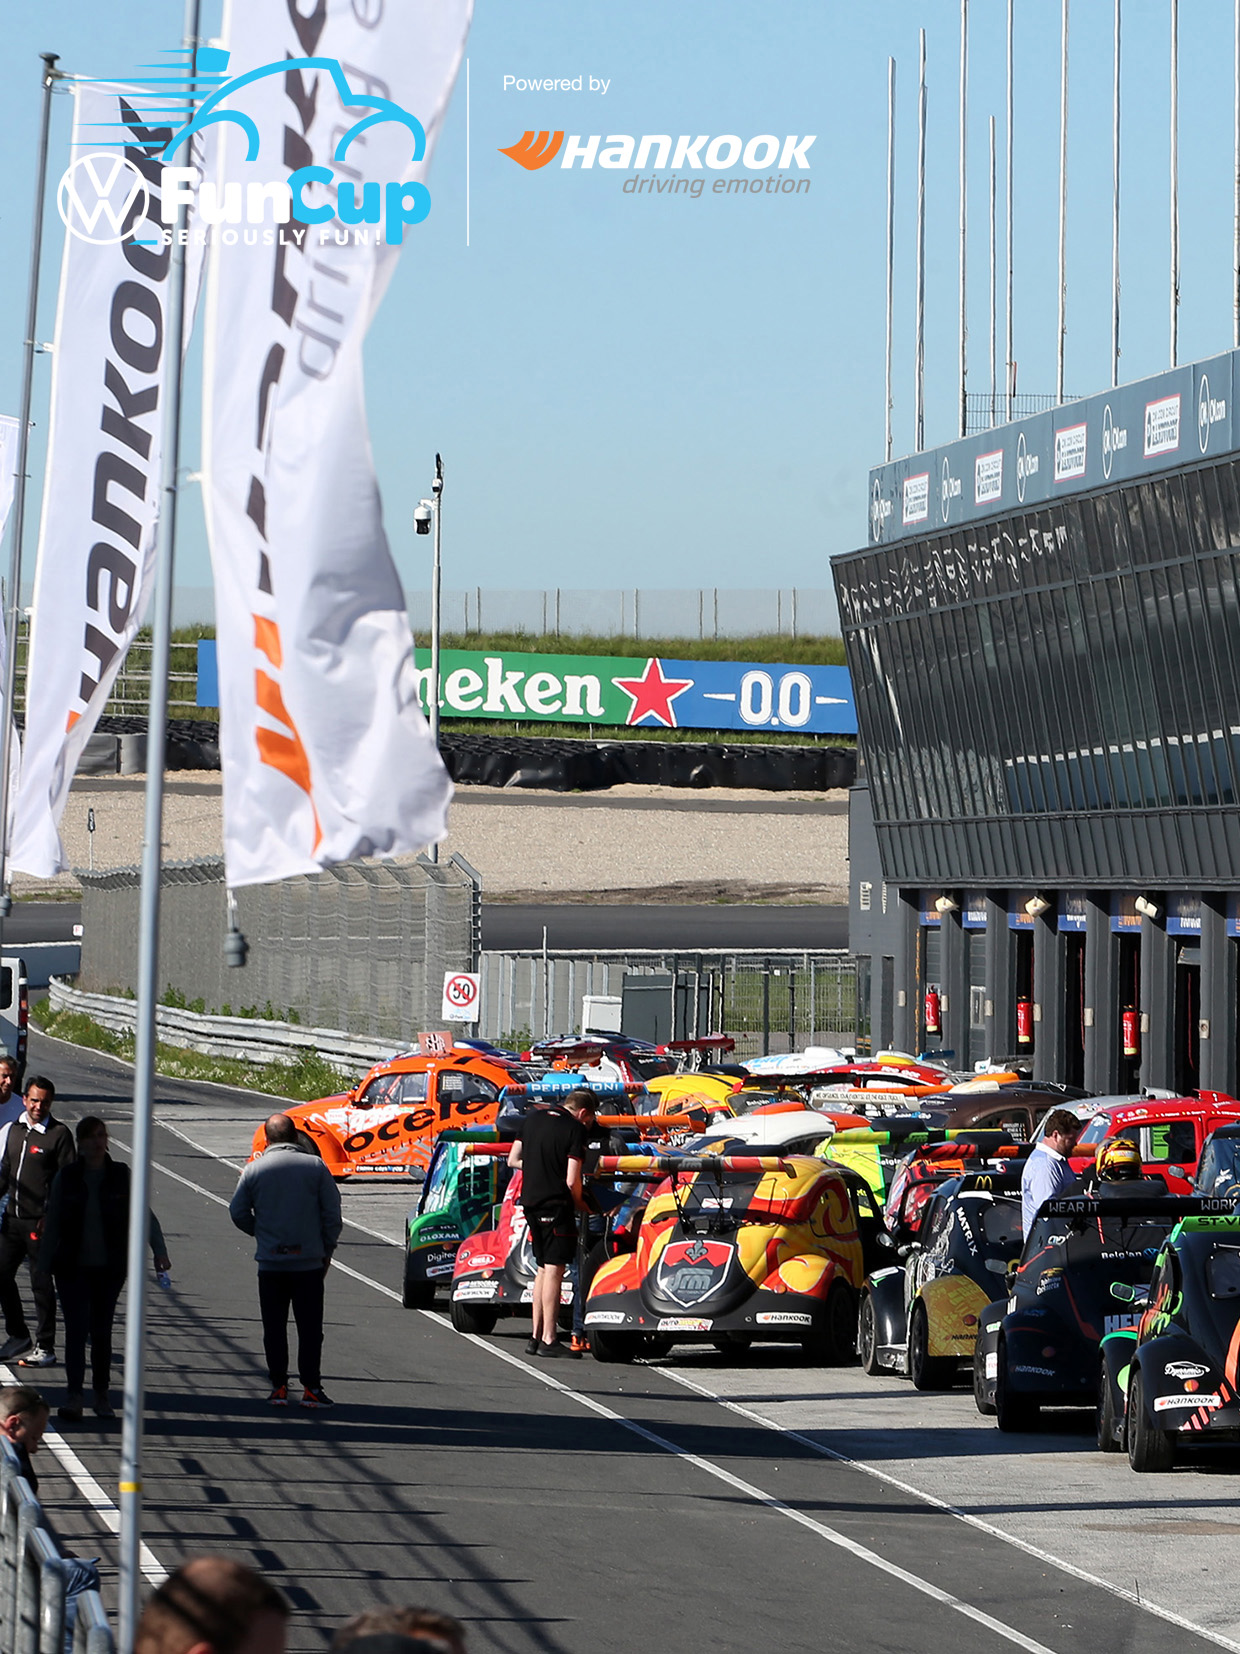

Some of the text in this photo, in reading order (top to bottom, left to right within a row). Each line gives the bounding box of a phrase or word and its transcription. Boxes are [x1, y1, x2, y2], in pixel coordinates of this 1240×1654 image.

[740, 670, 813, 728] 0.0
[453, 983, 470, 999] 50
[1050, 1202, 1084, 1213] WEAR
[1087, 1201, 1100, 1212] IT
[1201, 1199, 1237, 1211] WORK
[956, 1206, 978, 1256] MATRIX
